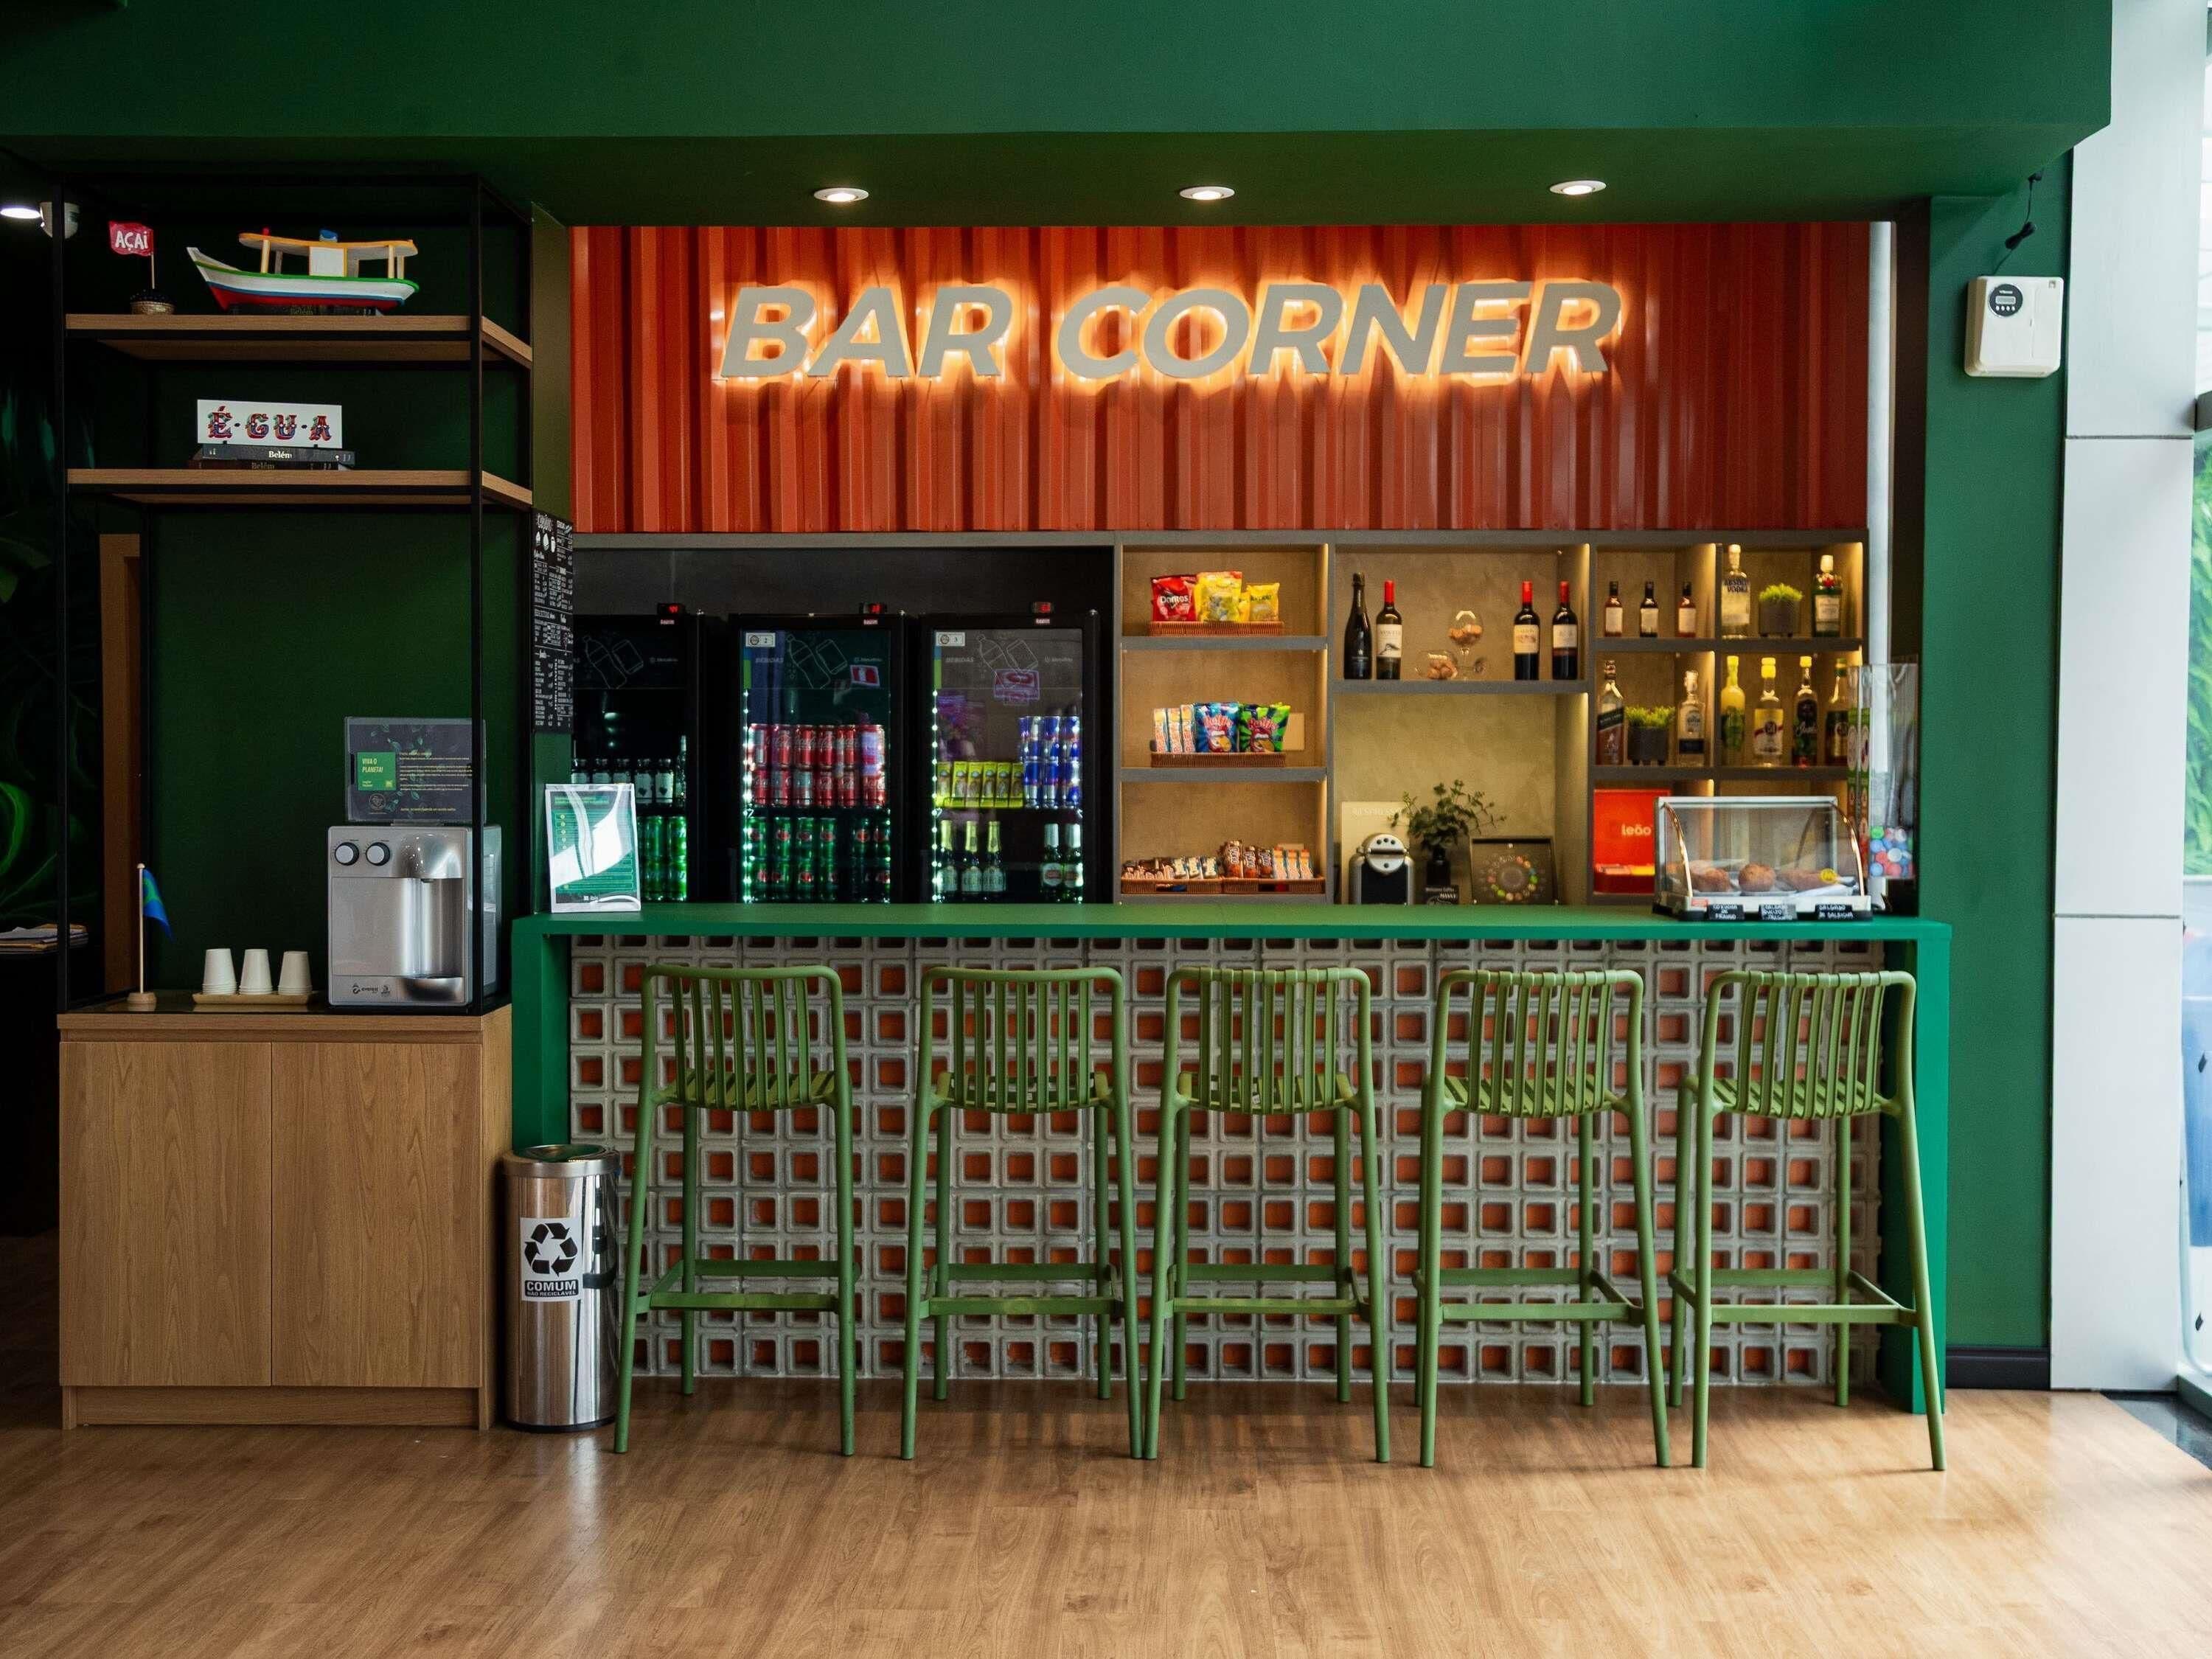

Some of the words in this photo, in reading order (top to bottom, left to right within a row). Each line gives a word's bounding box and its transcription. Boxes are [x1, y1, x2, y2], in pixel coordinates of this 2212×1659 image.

[720, 285, 1014, 378] BAR
[1056, 281, 1622, 380] CORNER
[268, 451, 292, 459] Belém
[1160, 595, 1189, 603] Doritos
[1621, 824, 1652, 837] leão
[526, 1281, 577, 1291] COMUM
